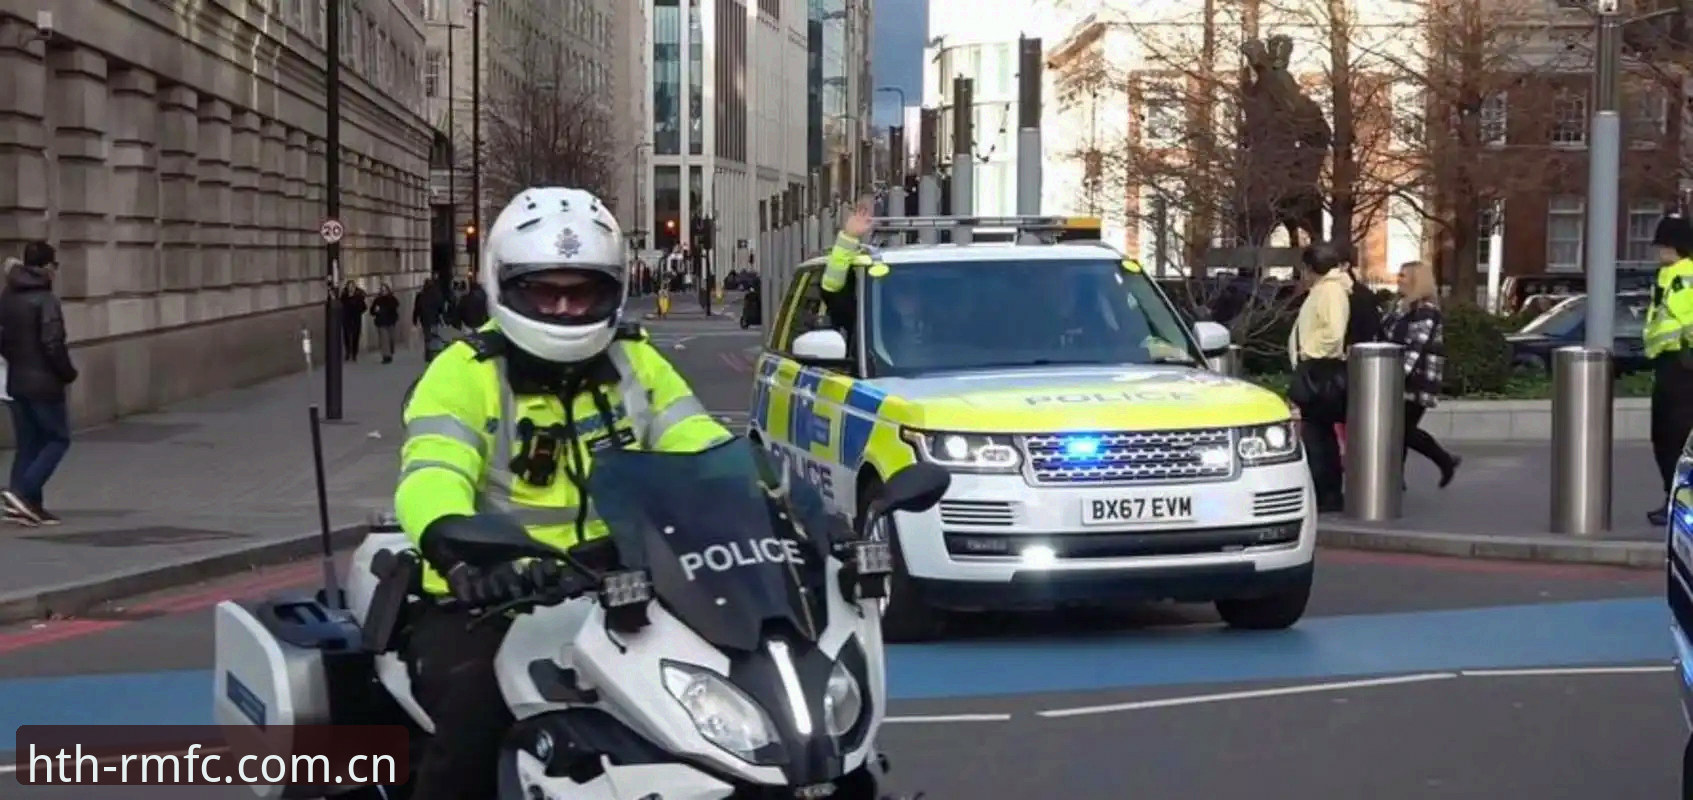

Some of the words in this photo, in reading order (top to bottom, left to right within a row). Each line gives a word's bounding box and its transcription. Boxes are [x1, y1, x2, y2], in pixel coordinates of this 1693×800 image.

[323, 224, 341, 237] 20
[1026, 391, 1197, 405] POLICE
[1092, 499, 1146, 520] BX67
[1152, 497, 1192, 517] EVM
[680, 538, 805, 581] POLICE
